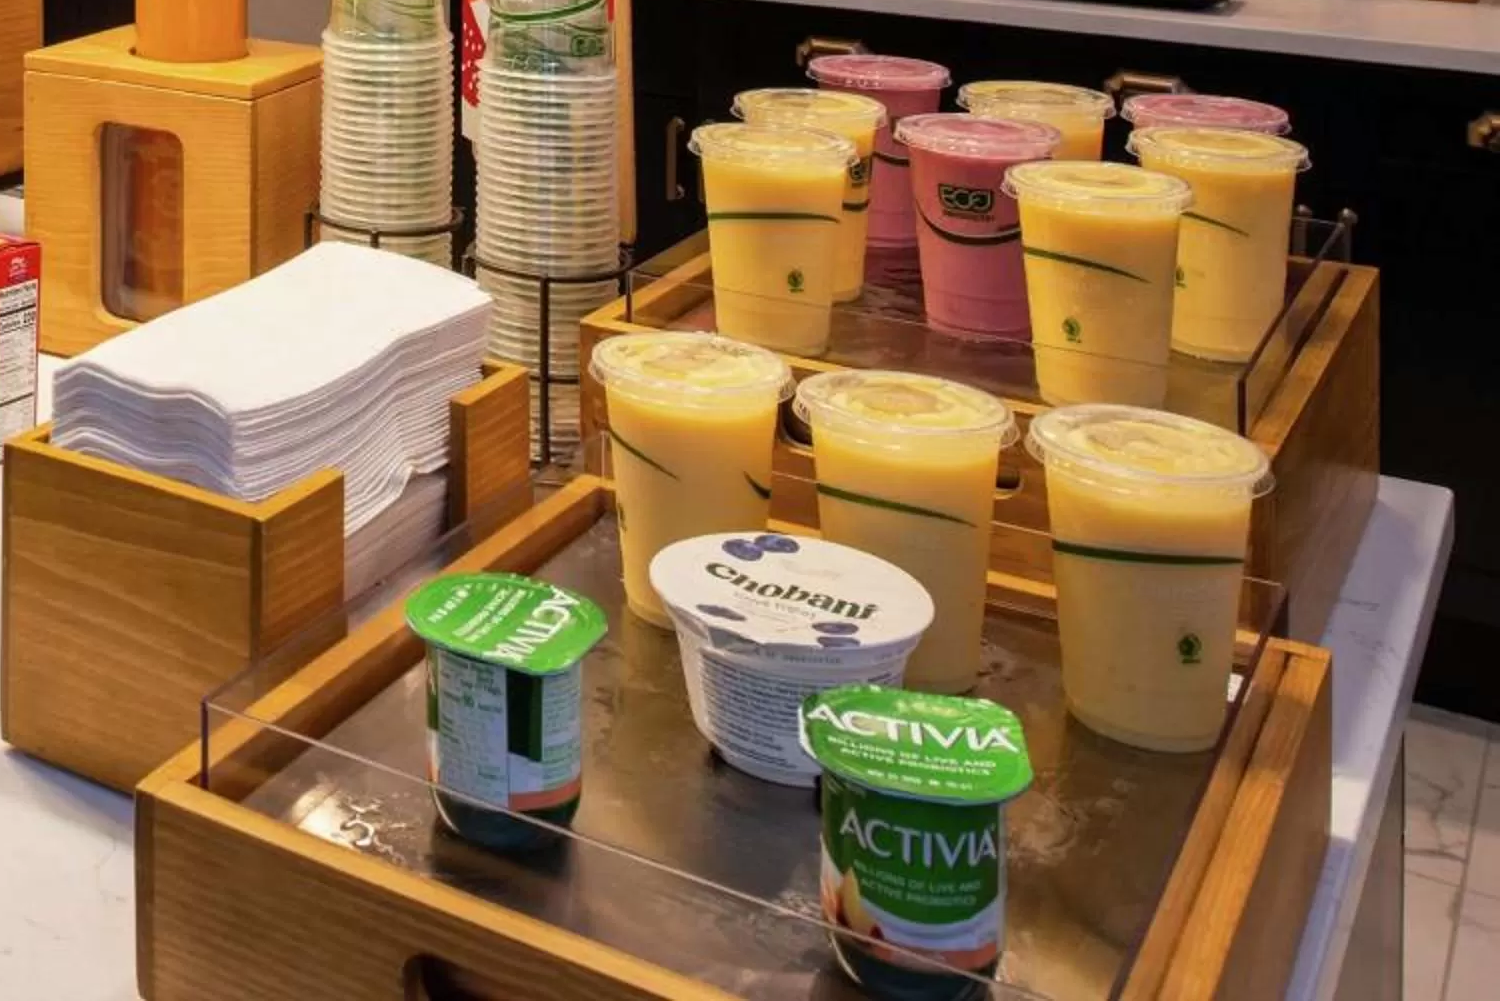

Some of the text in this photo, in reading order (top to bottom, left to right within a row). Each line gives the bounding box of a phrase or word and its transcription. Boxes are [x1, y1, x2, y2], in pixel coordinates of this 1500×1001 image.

[482, 584, 582, 664] ACTIVIA
[806, 703, 1020, 754] ACTIVIA
[827, 735, 997, 769] BILLIONS OF LIVE AND
[839, 806, 998, 870] ACTIVIA
